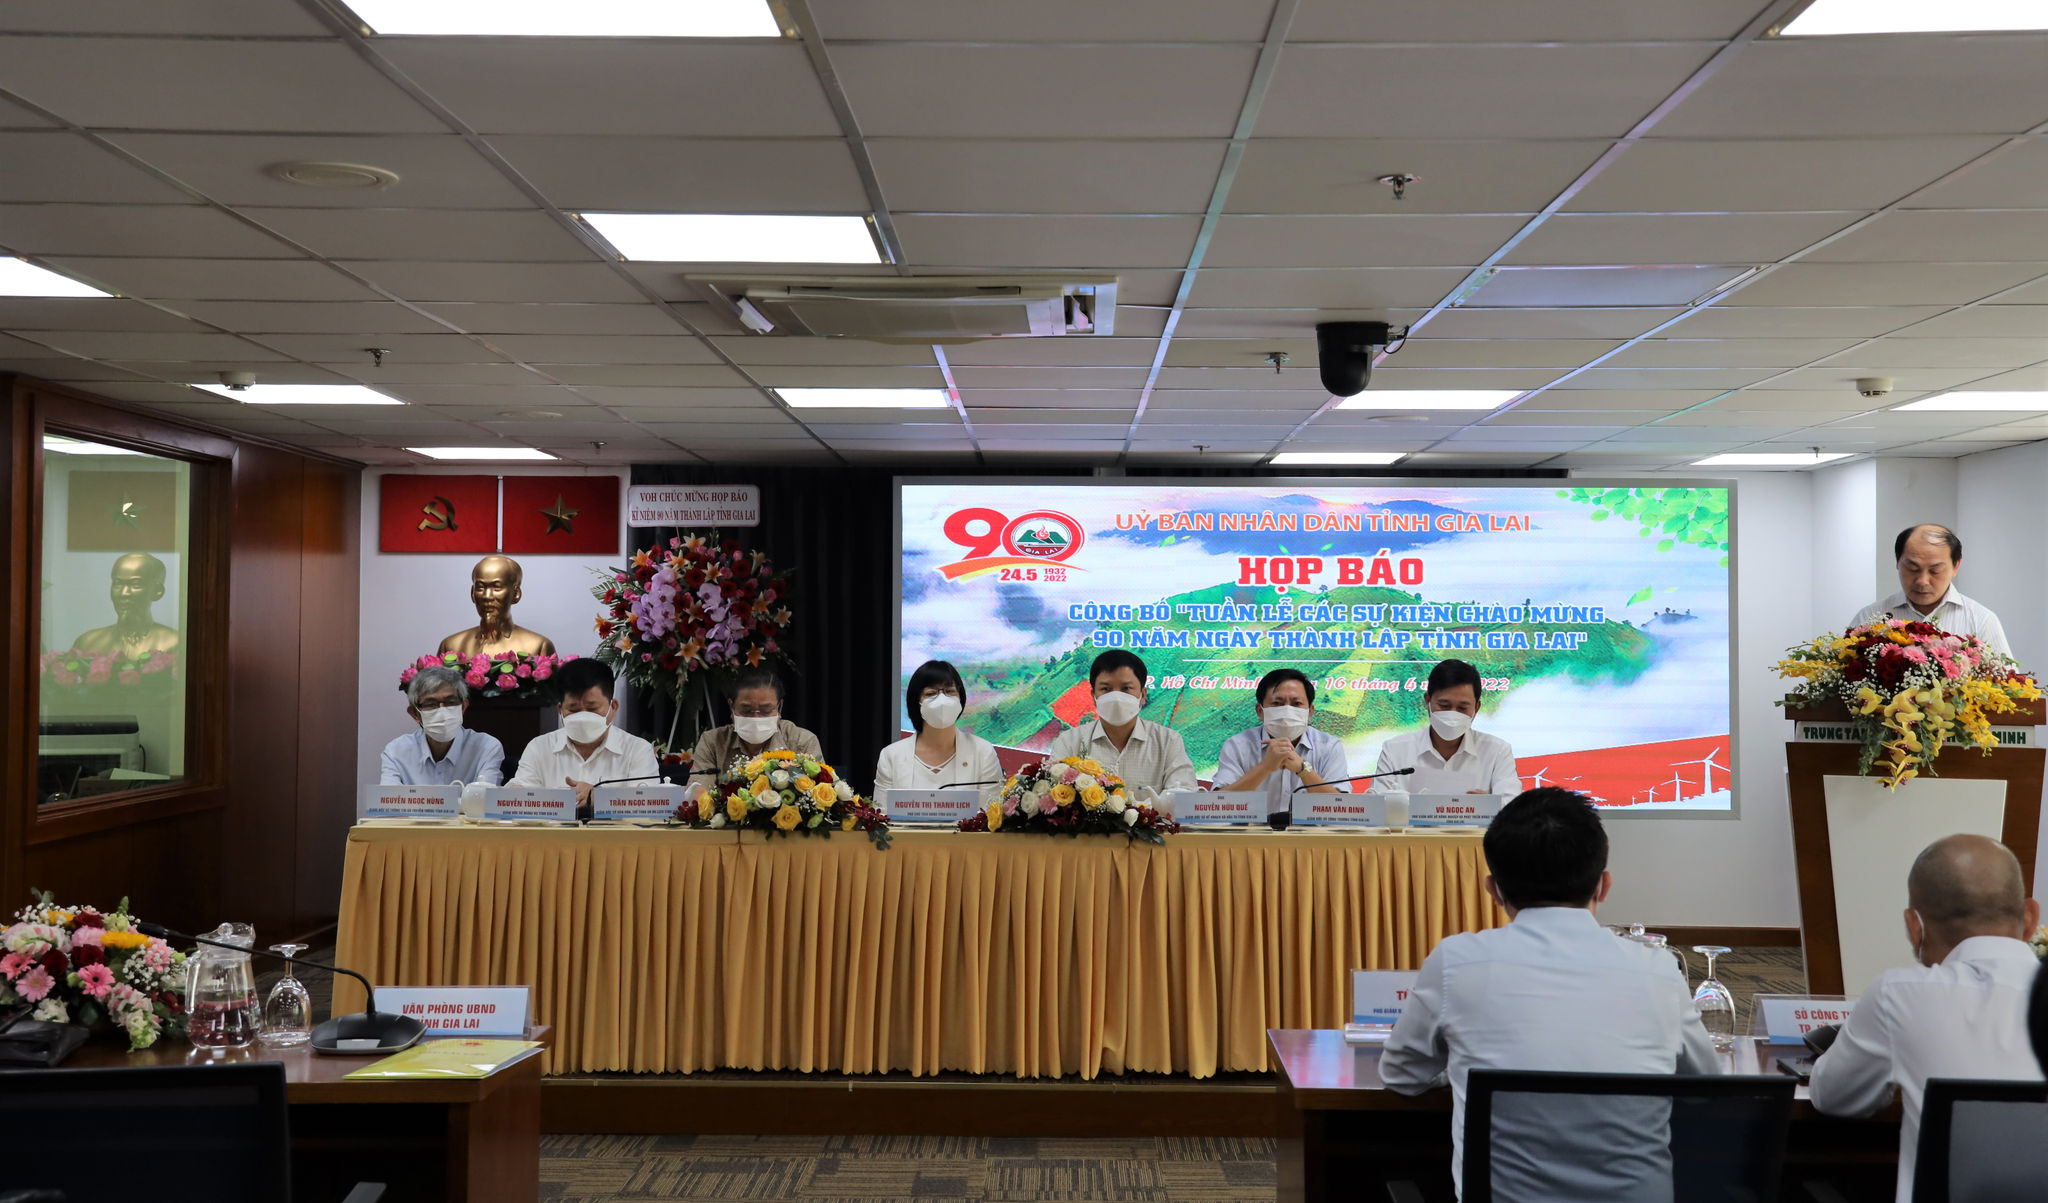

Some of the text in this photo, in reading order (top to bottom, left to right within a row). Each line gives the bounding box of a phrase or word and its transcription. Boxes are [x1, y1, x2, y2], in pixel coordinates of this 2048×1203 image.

[639, 492, 657, 502] VOH
[659, 489, 683, 502] CHÚC
[731, 489, 748, 502] BÁO
[732, 511, 744, 521] GIA
[744, 511, 756, 521] LAI
[1158, 513, 1213, 531] BAN
[1220, 511, 1298, 531] NHÂN
[1304, 511, 1362, 531] DÂN
[1365, 509, 1429, 532] TỈNH
[1435, 514, 1482, 532] GIA
[1489, 514, 1531, 532] LAI
[1000, 568, 1038, 582] 24.5
[1237, 549, 1424, 593] HỌP BÁO
[1068, 596, 1606, 627] CÔNG BỐ "TUẦN LỄ CÁC SỰ KIỆN CHÀO MỪNG
[1093, 627, 1588, 653] 90 NĂM NGÀY THÀNH LẬP TỈNH GIA LAI"
[1325, 676, 1346, 690] 16
[1350, 676, 1400, 692] tháng
[1404, 676, 1417, 692] 4
[1480, 677, 1511, 691] 22
[1803, 726, 1843, 740] TRUNG
[933, 801, 955, 809] THANH
[1465, 806, 1475, 814] AN
[402, 1001, 496, 1014] VĂN PHÒNG UBND
[1810, 1008, 1839, 1021] CÔNG
[442, 1018, 460, 1029] GIA
[463, 1018, 480, 1029] LAI
